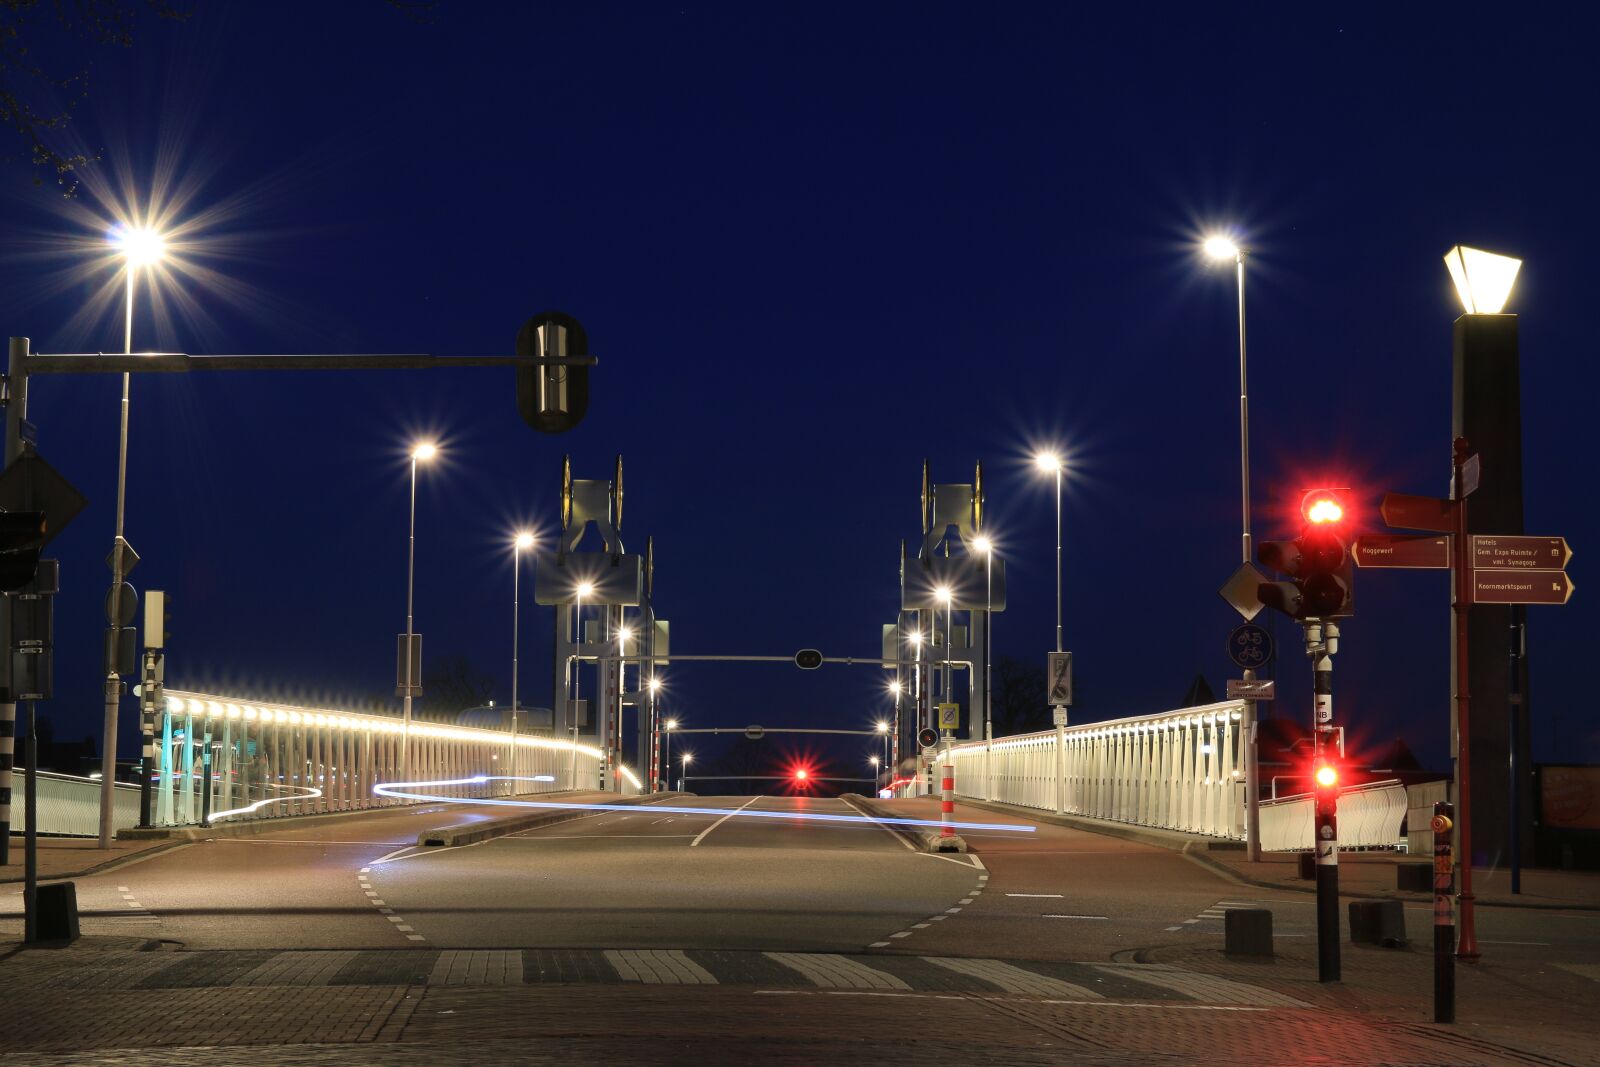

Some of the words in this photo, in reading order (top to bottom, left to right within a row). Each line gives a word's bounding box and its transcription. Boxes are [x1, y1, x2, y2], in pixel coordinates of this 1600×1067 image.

[1362, 546, 1393, 556] Koggewerf
[1494, 548, 1509, 556] Expo
[1507, 558, 1537, 567] Synagoge
[1478, 583, 1532, 591] Koornmarktspoort
